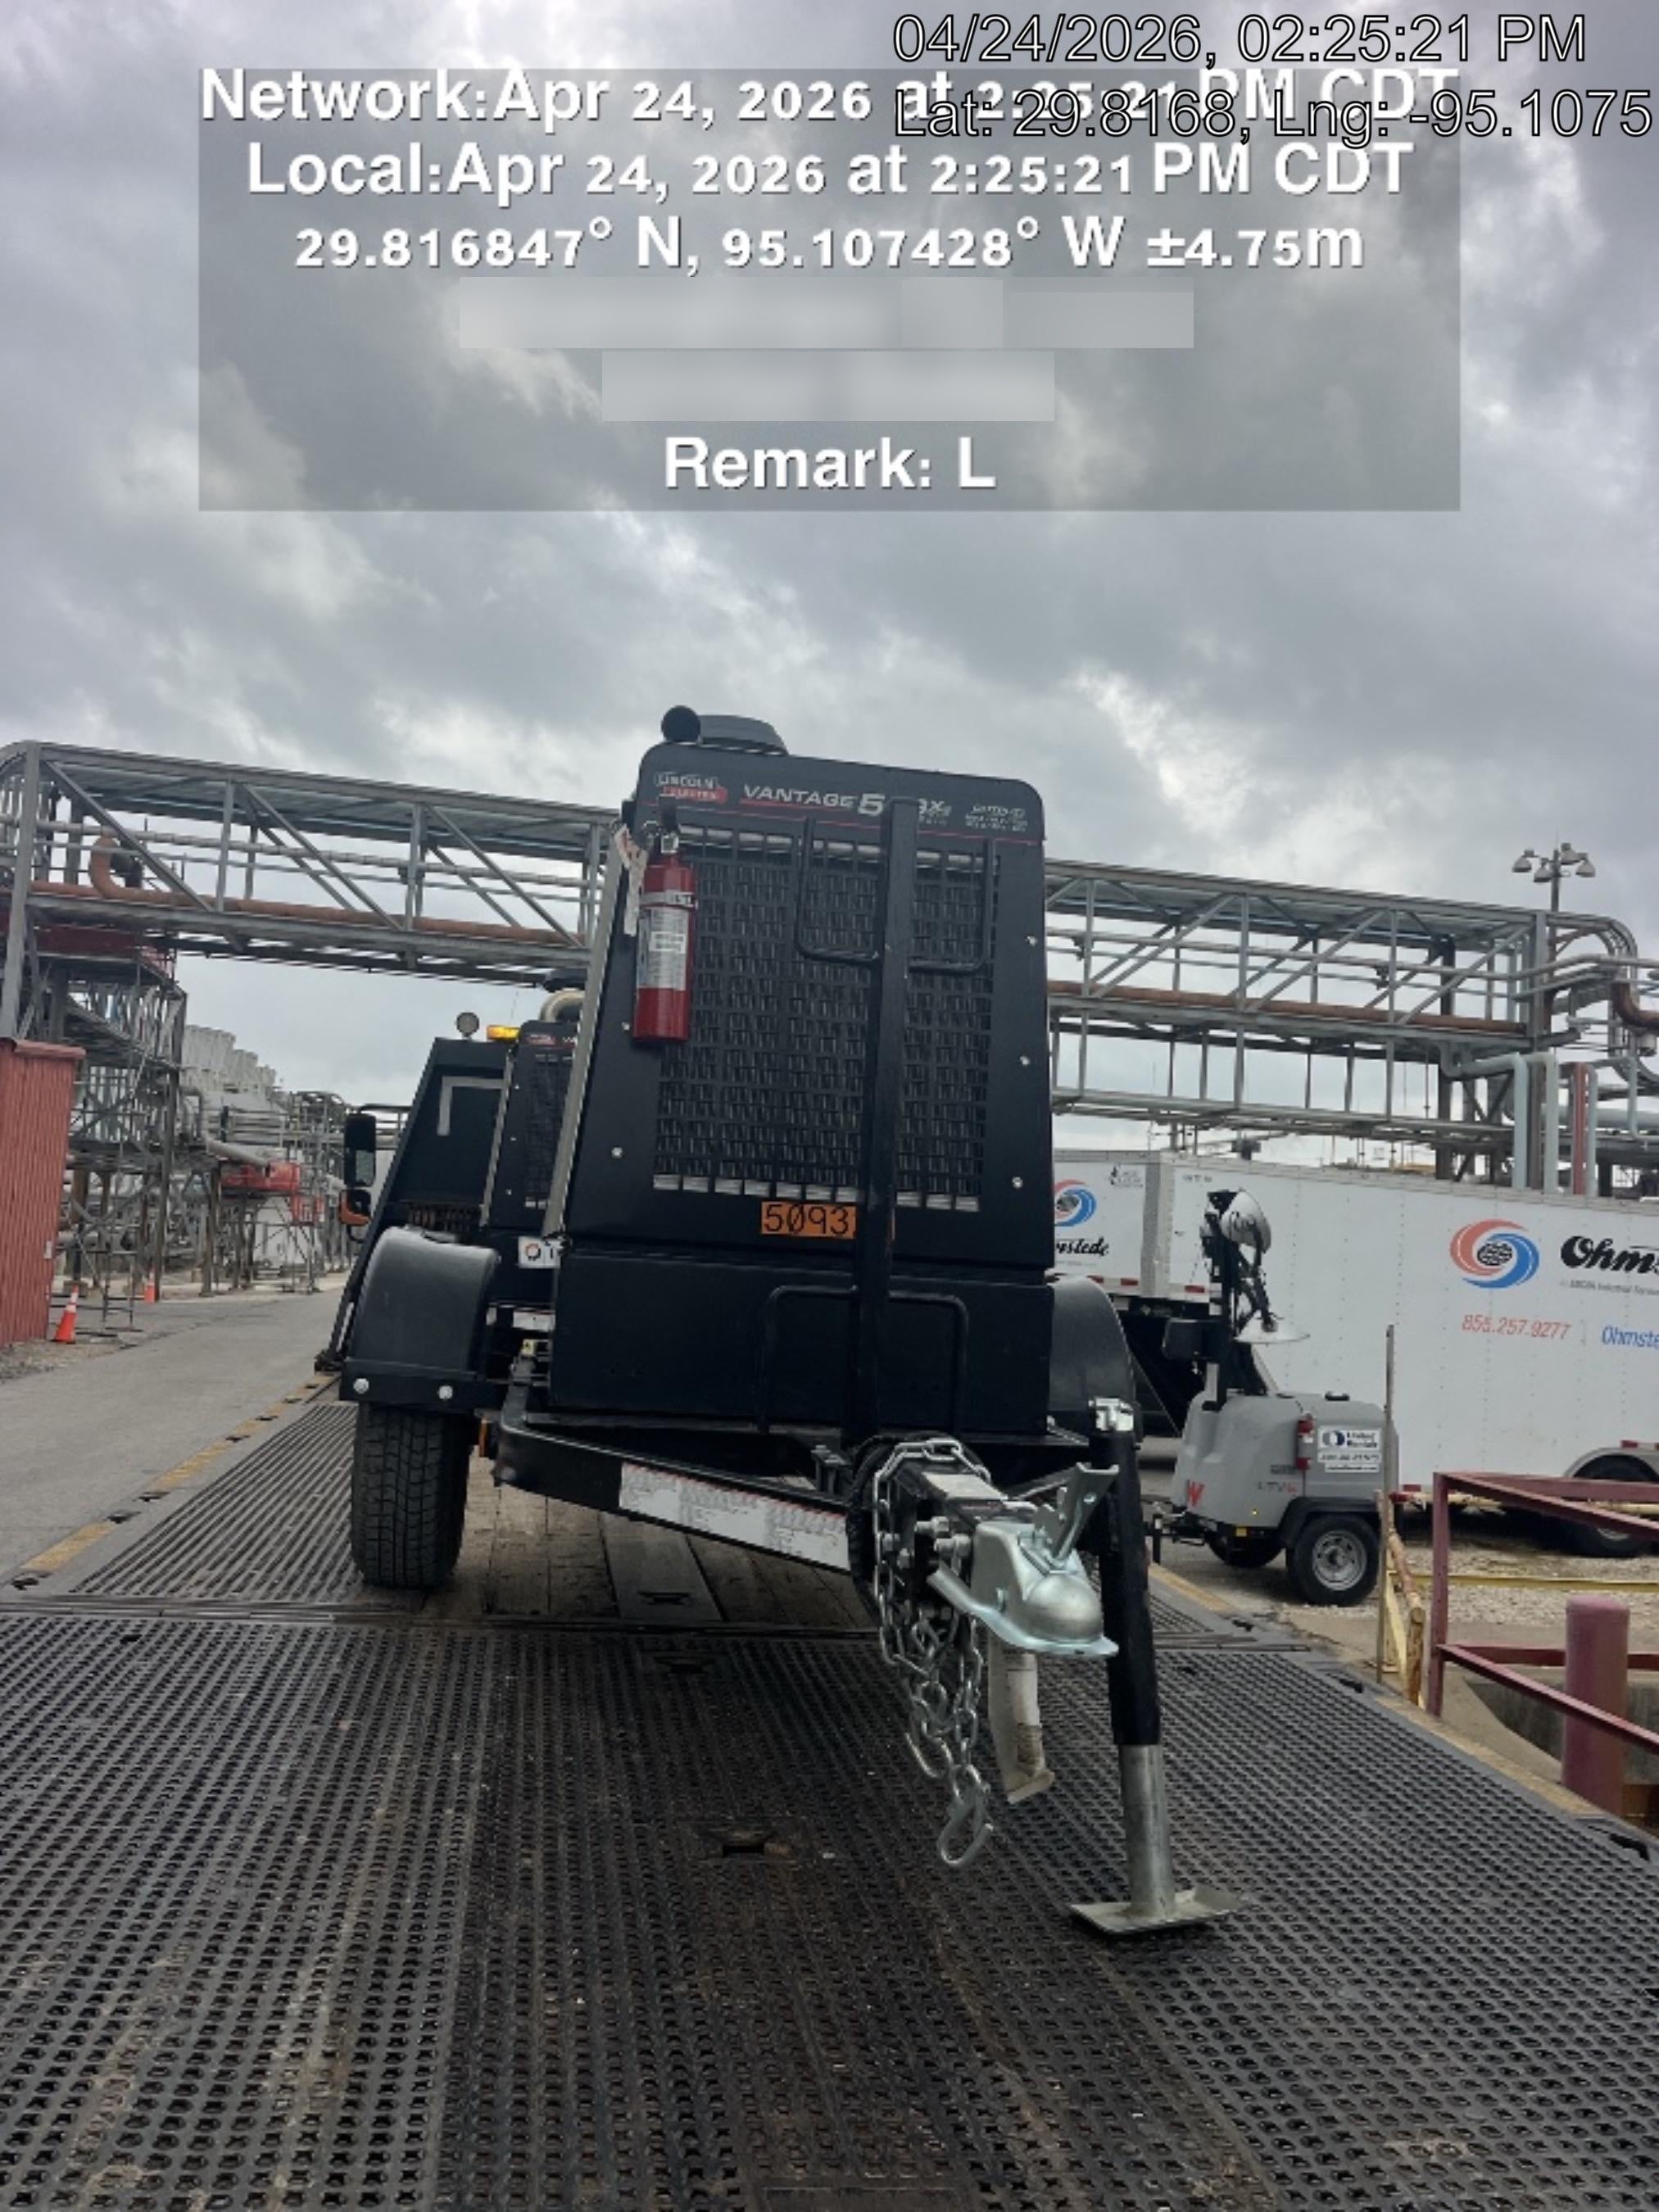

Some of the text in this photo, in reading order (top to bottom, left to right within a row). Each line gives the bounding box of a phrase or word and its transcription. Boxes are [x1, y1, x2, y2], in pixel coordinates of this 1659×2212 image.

[744, 783, 859, 809] VANTAGE
[764, 1203, 856, 1235] 5093
[1462, 1314, 1571, 1340] 855.257.9277
